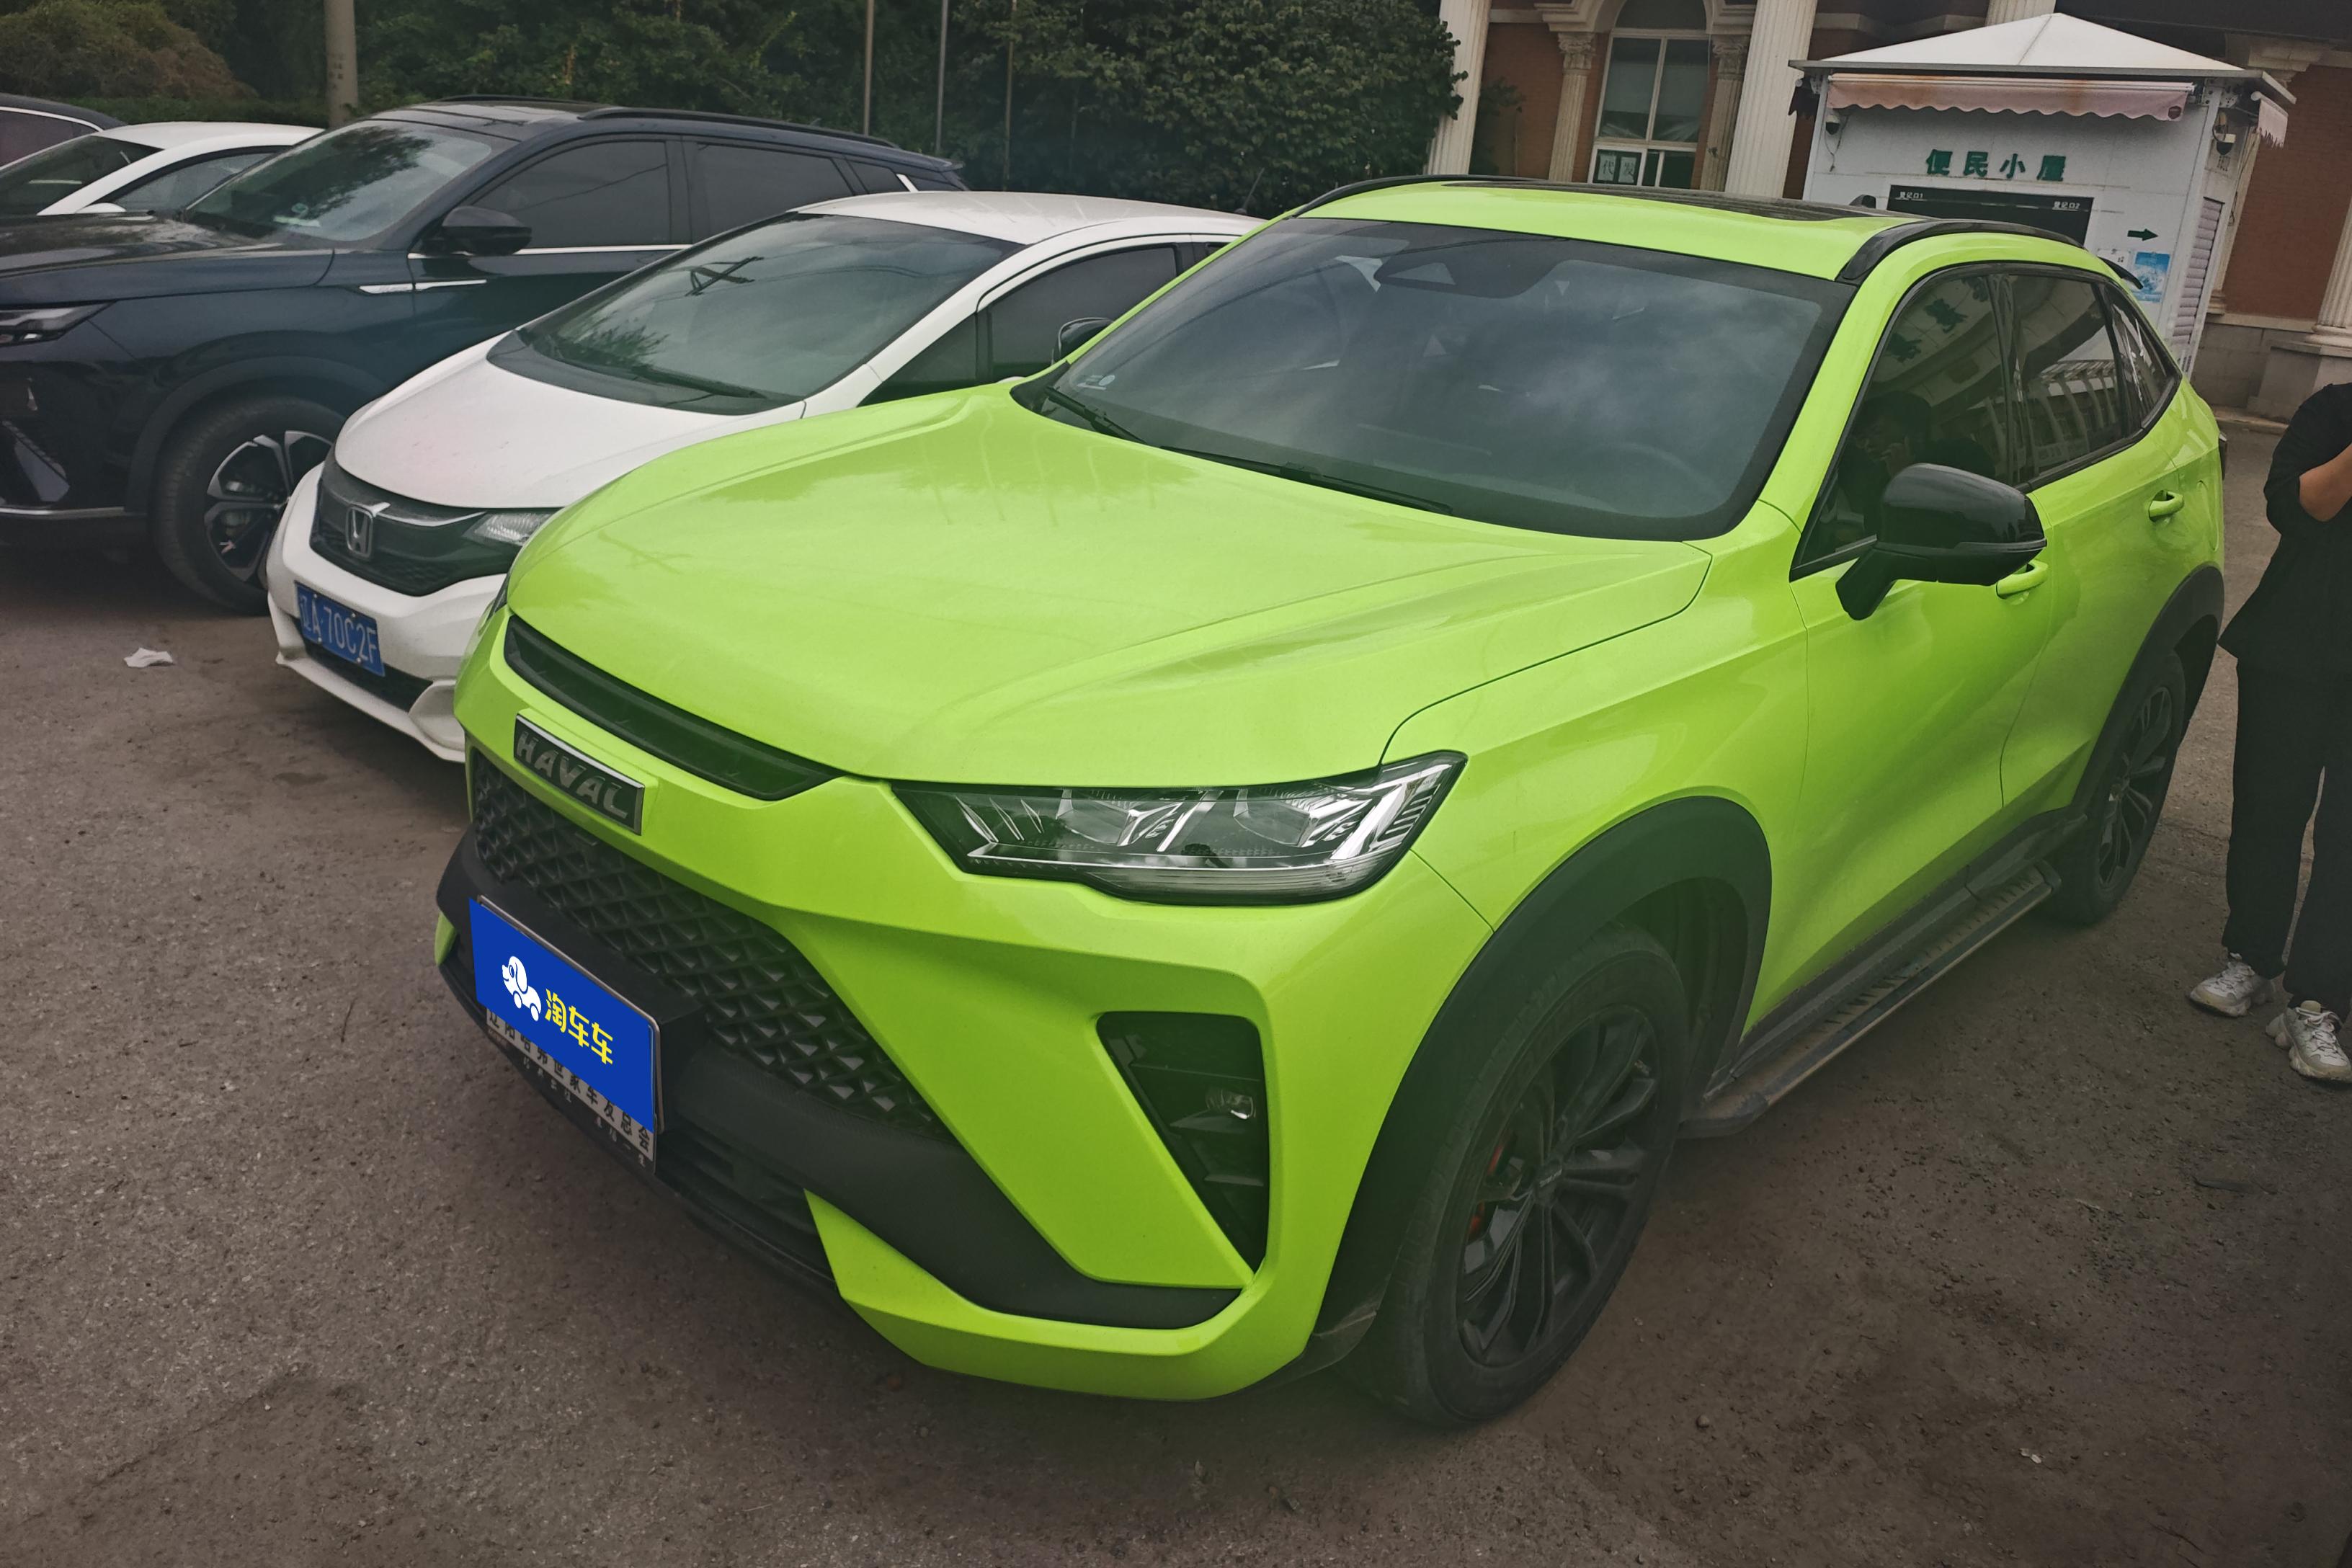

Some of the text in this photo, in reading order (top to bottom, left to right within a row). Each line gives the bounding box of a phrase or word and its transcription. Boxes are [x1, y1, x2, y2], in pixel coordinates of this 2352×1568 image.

[1925, 148, 2067, 182] 便民小屋
[515, 731, 629, 819] HAVAL
